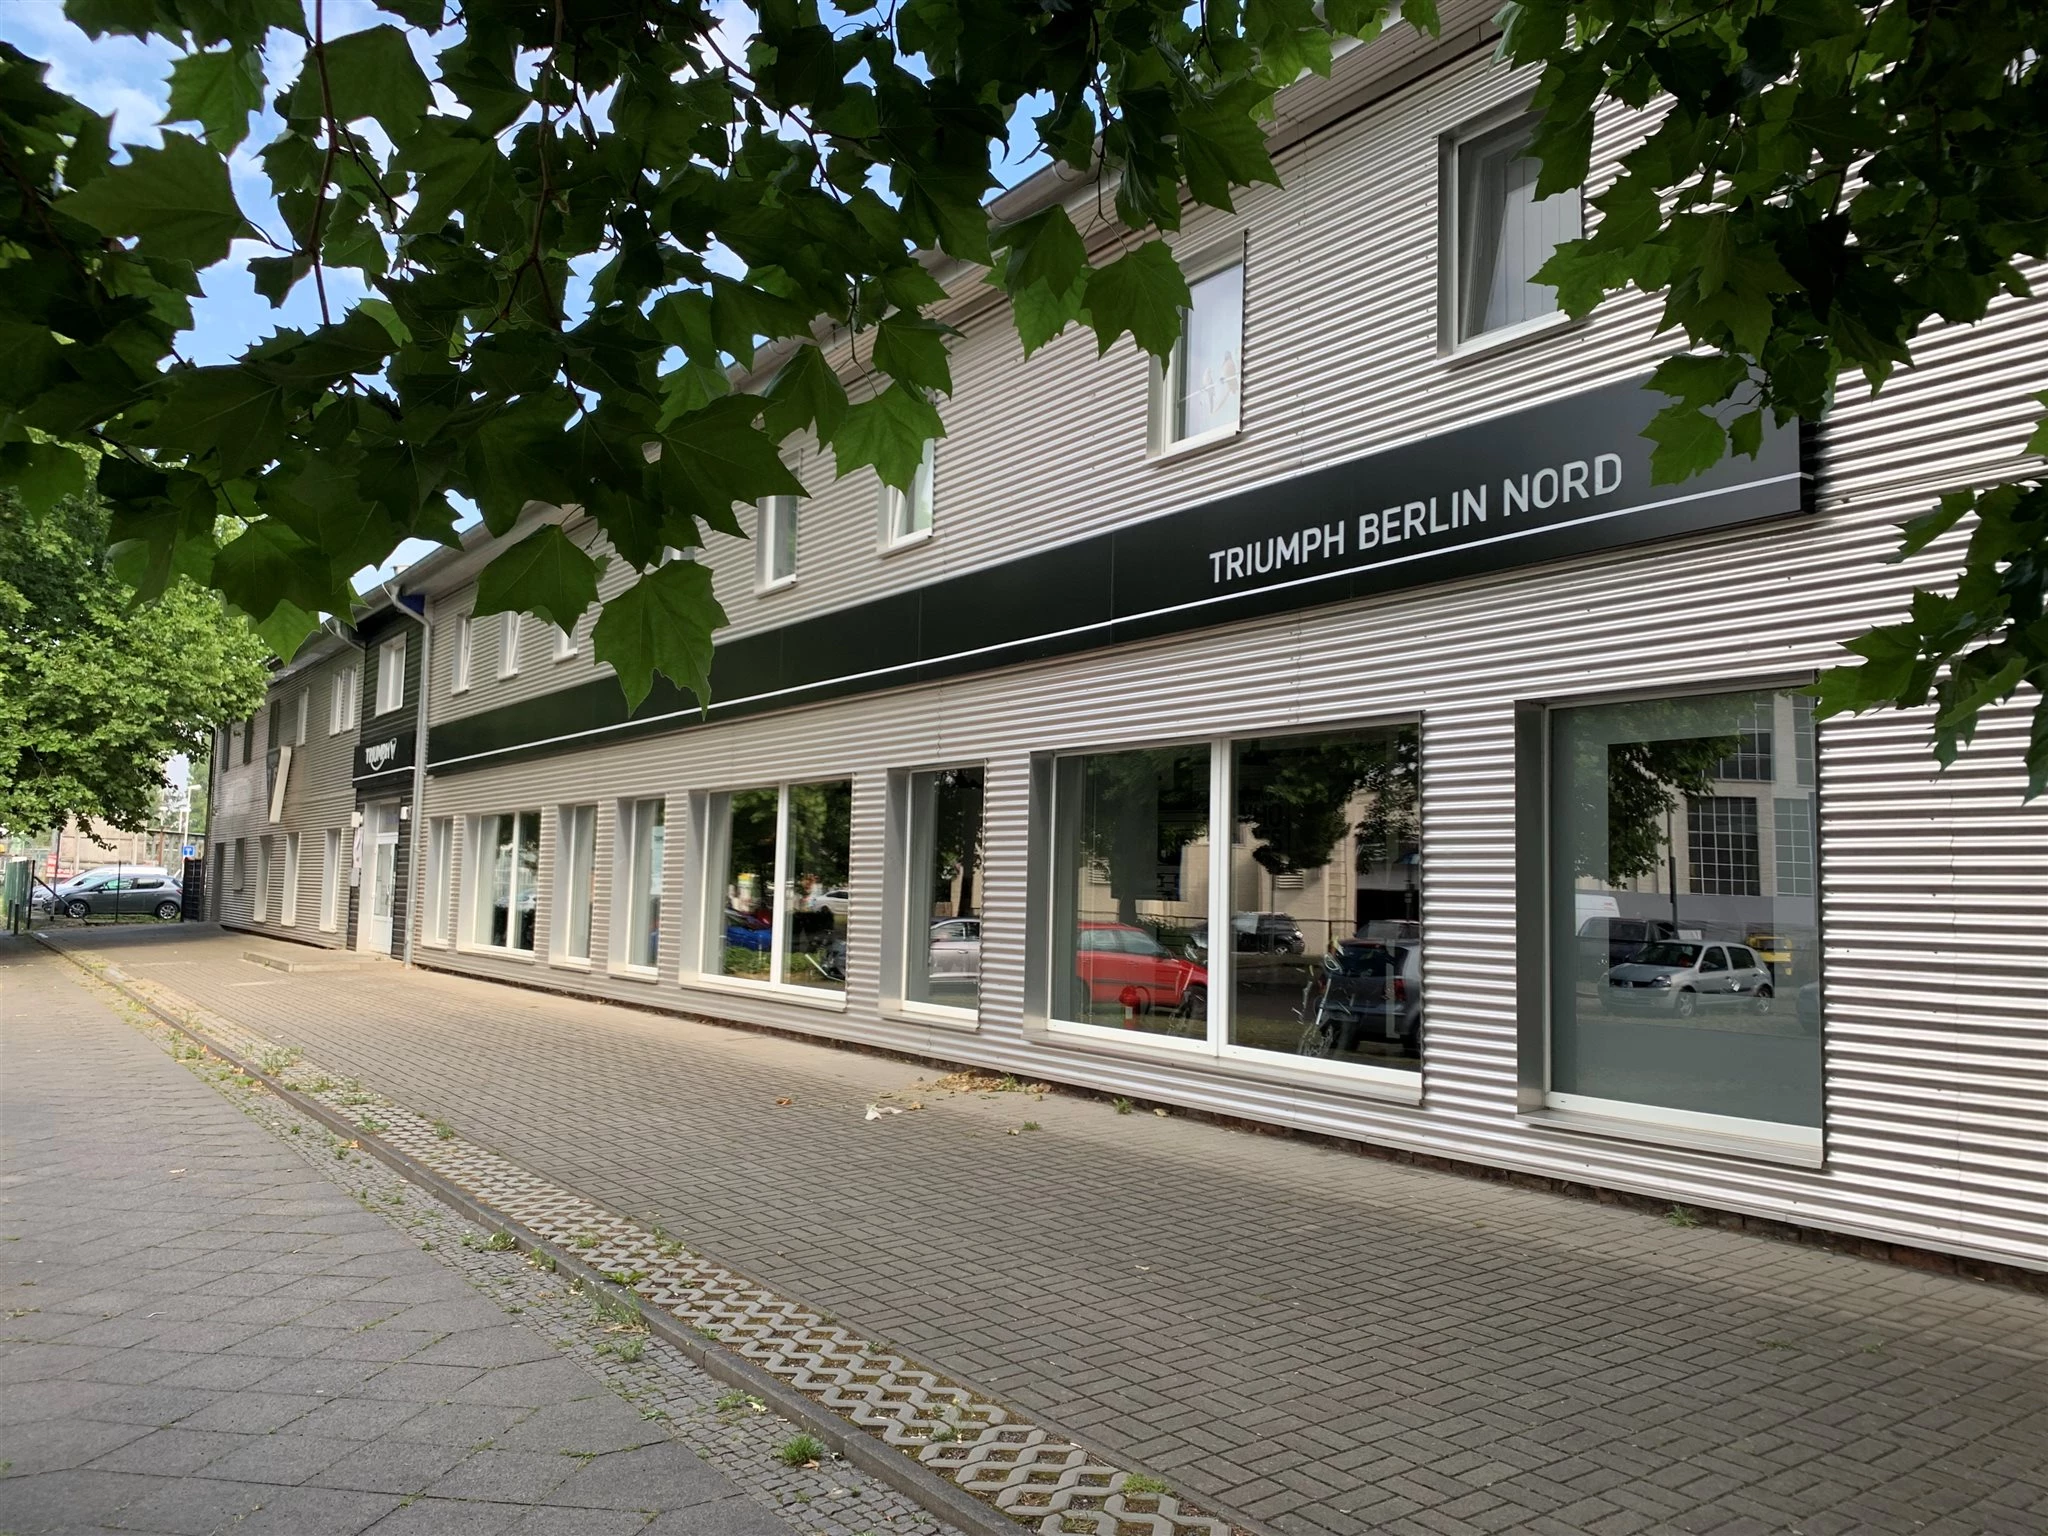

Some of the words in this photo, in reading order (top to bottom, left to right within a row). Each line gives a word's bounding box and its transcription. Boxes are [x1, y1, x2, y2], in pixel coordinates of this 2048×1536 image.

[1209, 520, 1345, 583] TRIUMPH
[1358, 484, 1487, 550] BERLIN
[1502, 452, 1623, 517] NORD
